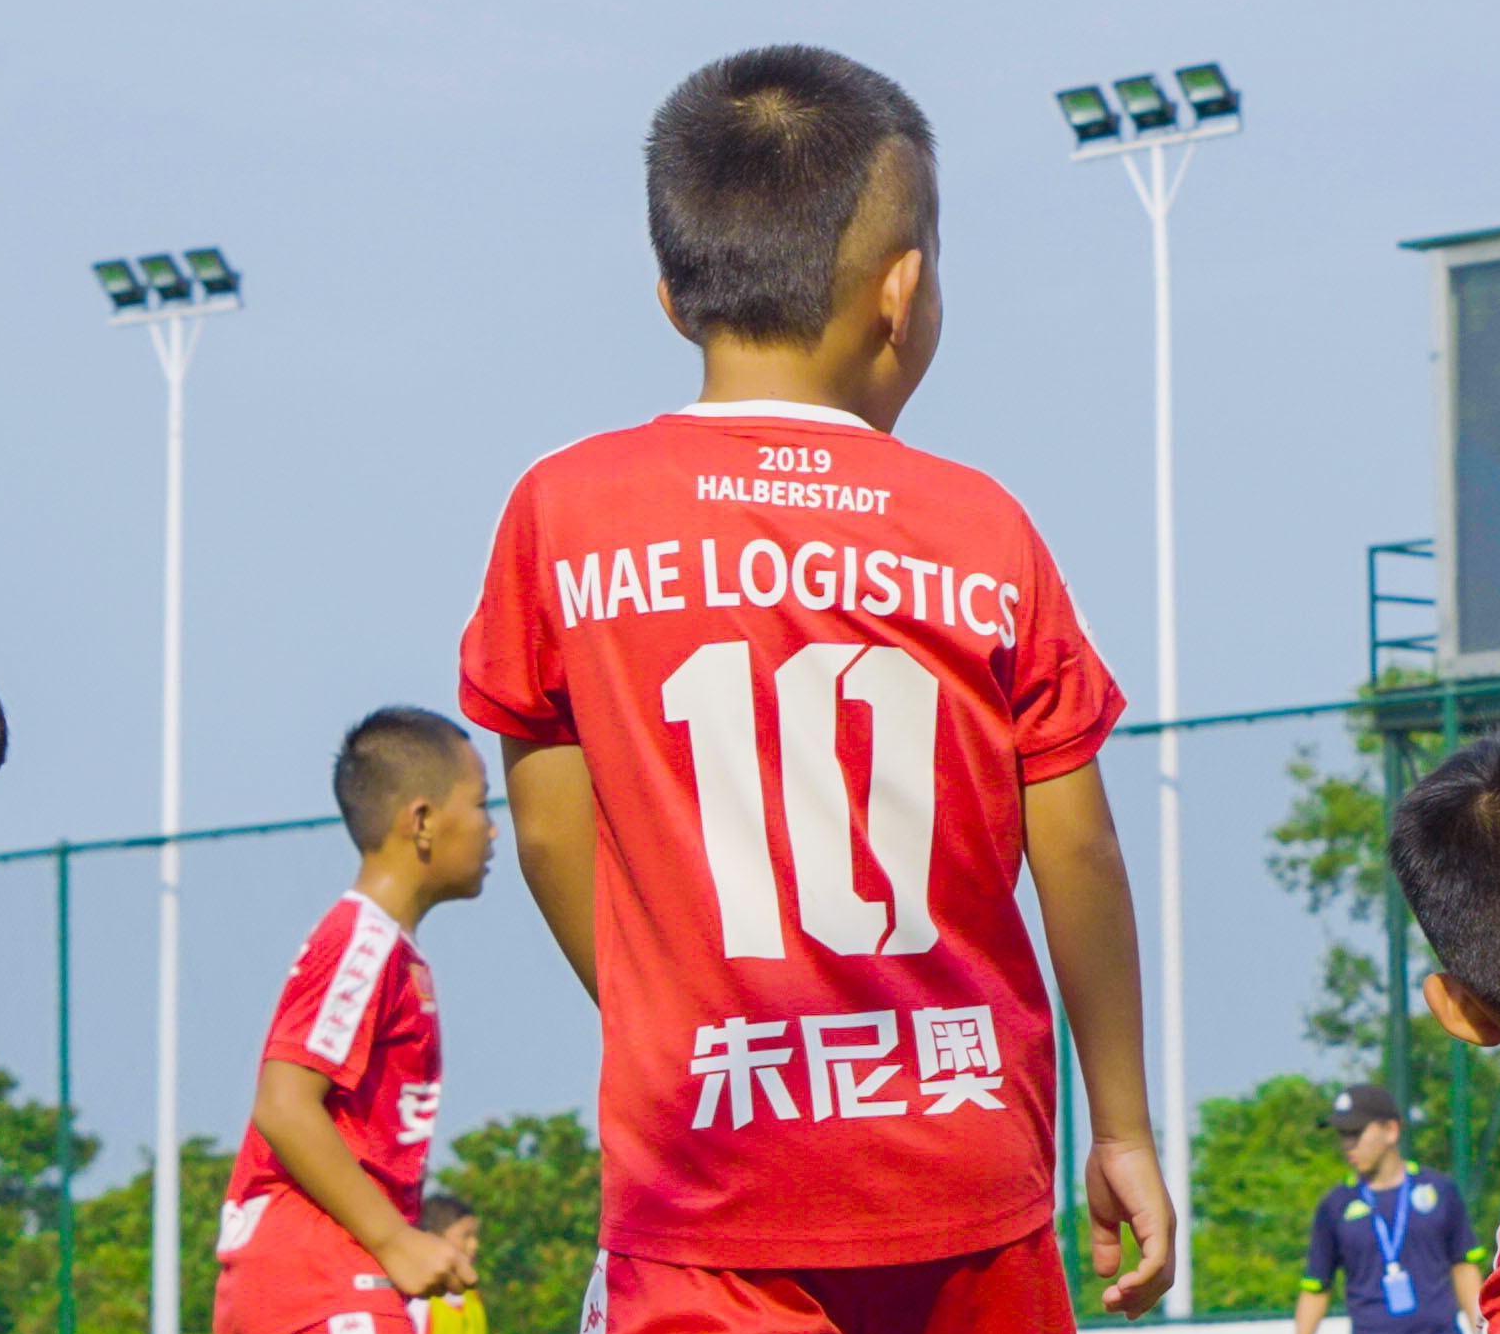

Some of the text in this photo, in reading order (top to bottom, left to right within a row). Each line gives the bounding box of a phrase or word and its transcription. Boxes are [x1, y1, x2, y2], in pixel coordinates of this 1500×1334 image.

[697, 475, 890, 515] HALBERSTADT
[758, 447, 832, 473] 2019
[556, 539, 1019, 649] MAE LOGISTICS
[662, 640, 939, 959] 10
[690, 1005, 1007, 1131] 朱尼奥
